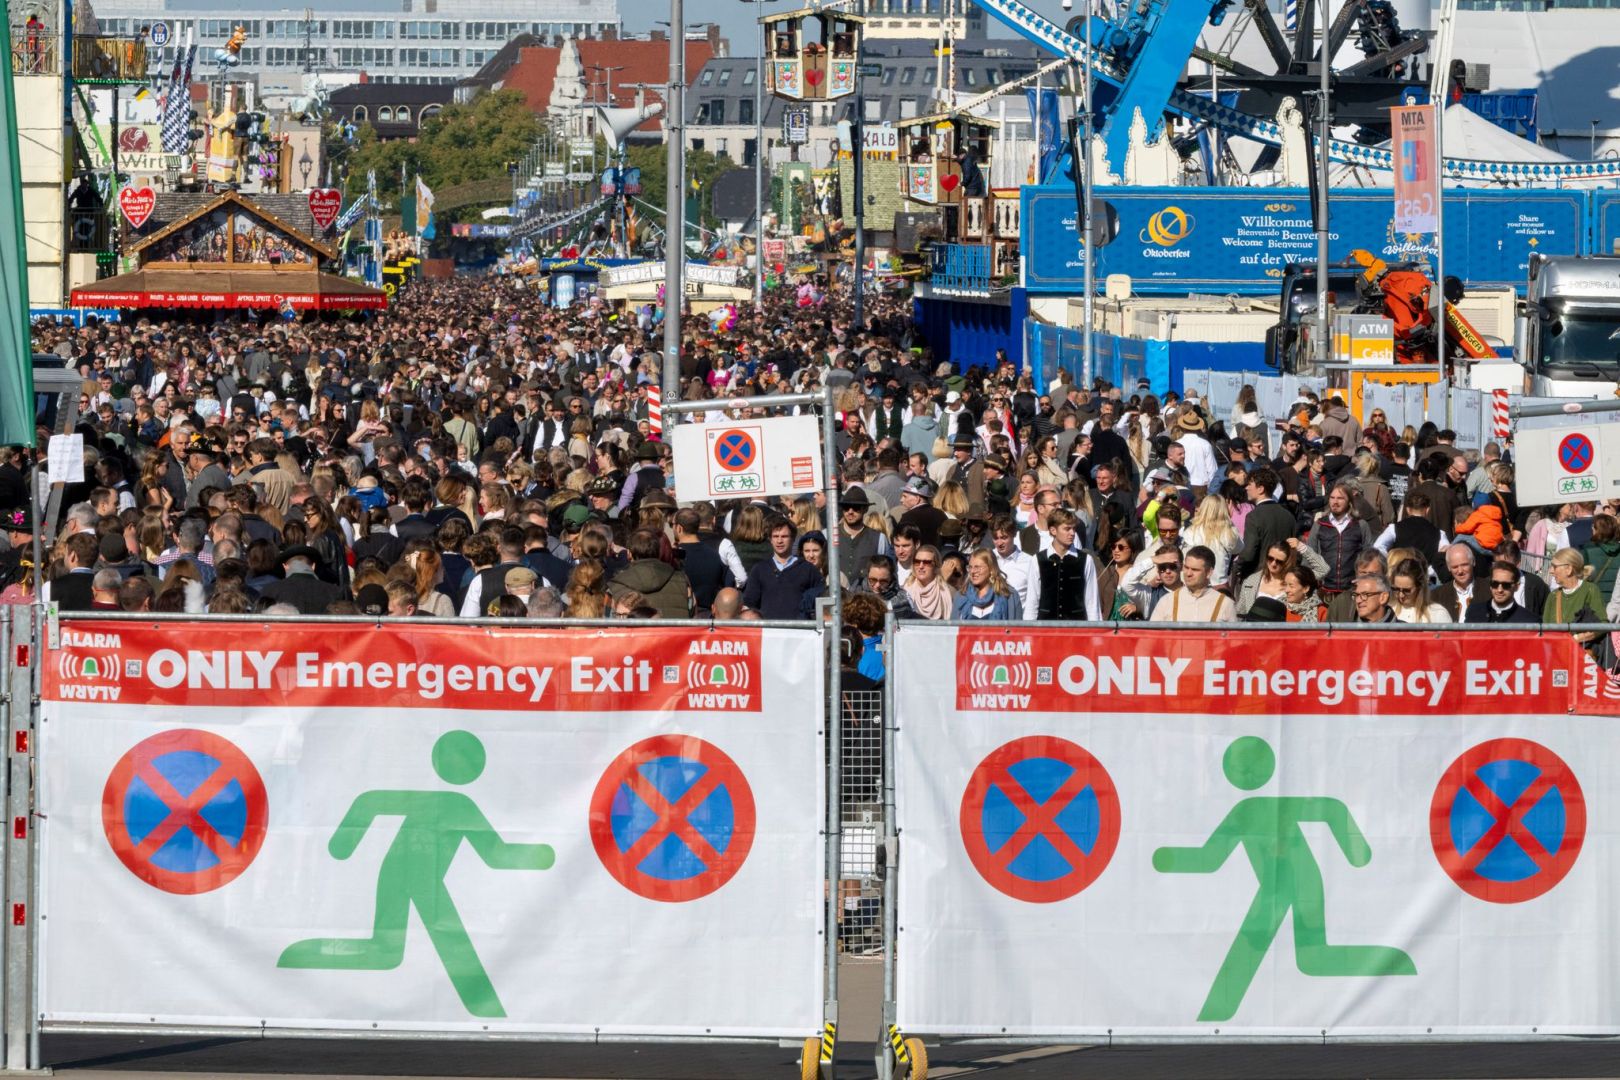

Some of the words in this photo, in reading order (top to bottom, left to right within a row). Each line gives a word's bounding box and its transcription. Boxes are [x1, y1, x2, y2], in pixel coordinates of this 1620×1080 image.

[1241, 216, 1313, 228] Willkomme
[1237, 228, 1279, 236] Bienvenido
[1282, 230, 1339, 240] Benveto
[1222, 237, 1263, 246] Welcome
[1268, 239, 1313, 248] Bienvenue
[1143, 249, 1190, 258] Oktoberfest
[1240, 253, 1260, 264] auf
[1261, 253, 1281, 264] der
[1358, 324, 1388, 335] ATM
[1450, 314, 1483, 352] PALFINGER
[1362, 348, 1393, 360] Cash
[61, 633, 121, 649] ALARM
[688, 640, 749, 656] ALARM
[971, 640, 1031, 656] ALARM
[147, 649, 284, 689] ONLY
[296, 652, 553, 703] Emergency
[571, 655, 652, 693] Exit
[1058, 655, 1192, 696] ONLY
[1203, 659, 1451, 706] Emergency
[1465, 659, 1543, 695] Exit
[59, 685, 121, 701] ALARM
[688, 693, 749, 709] ALARM
[971, 694, 1031, 709] ALARM
